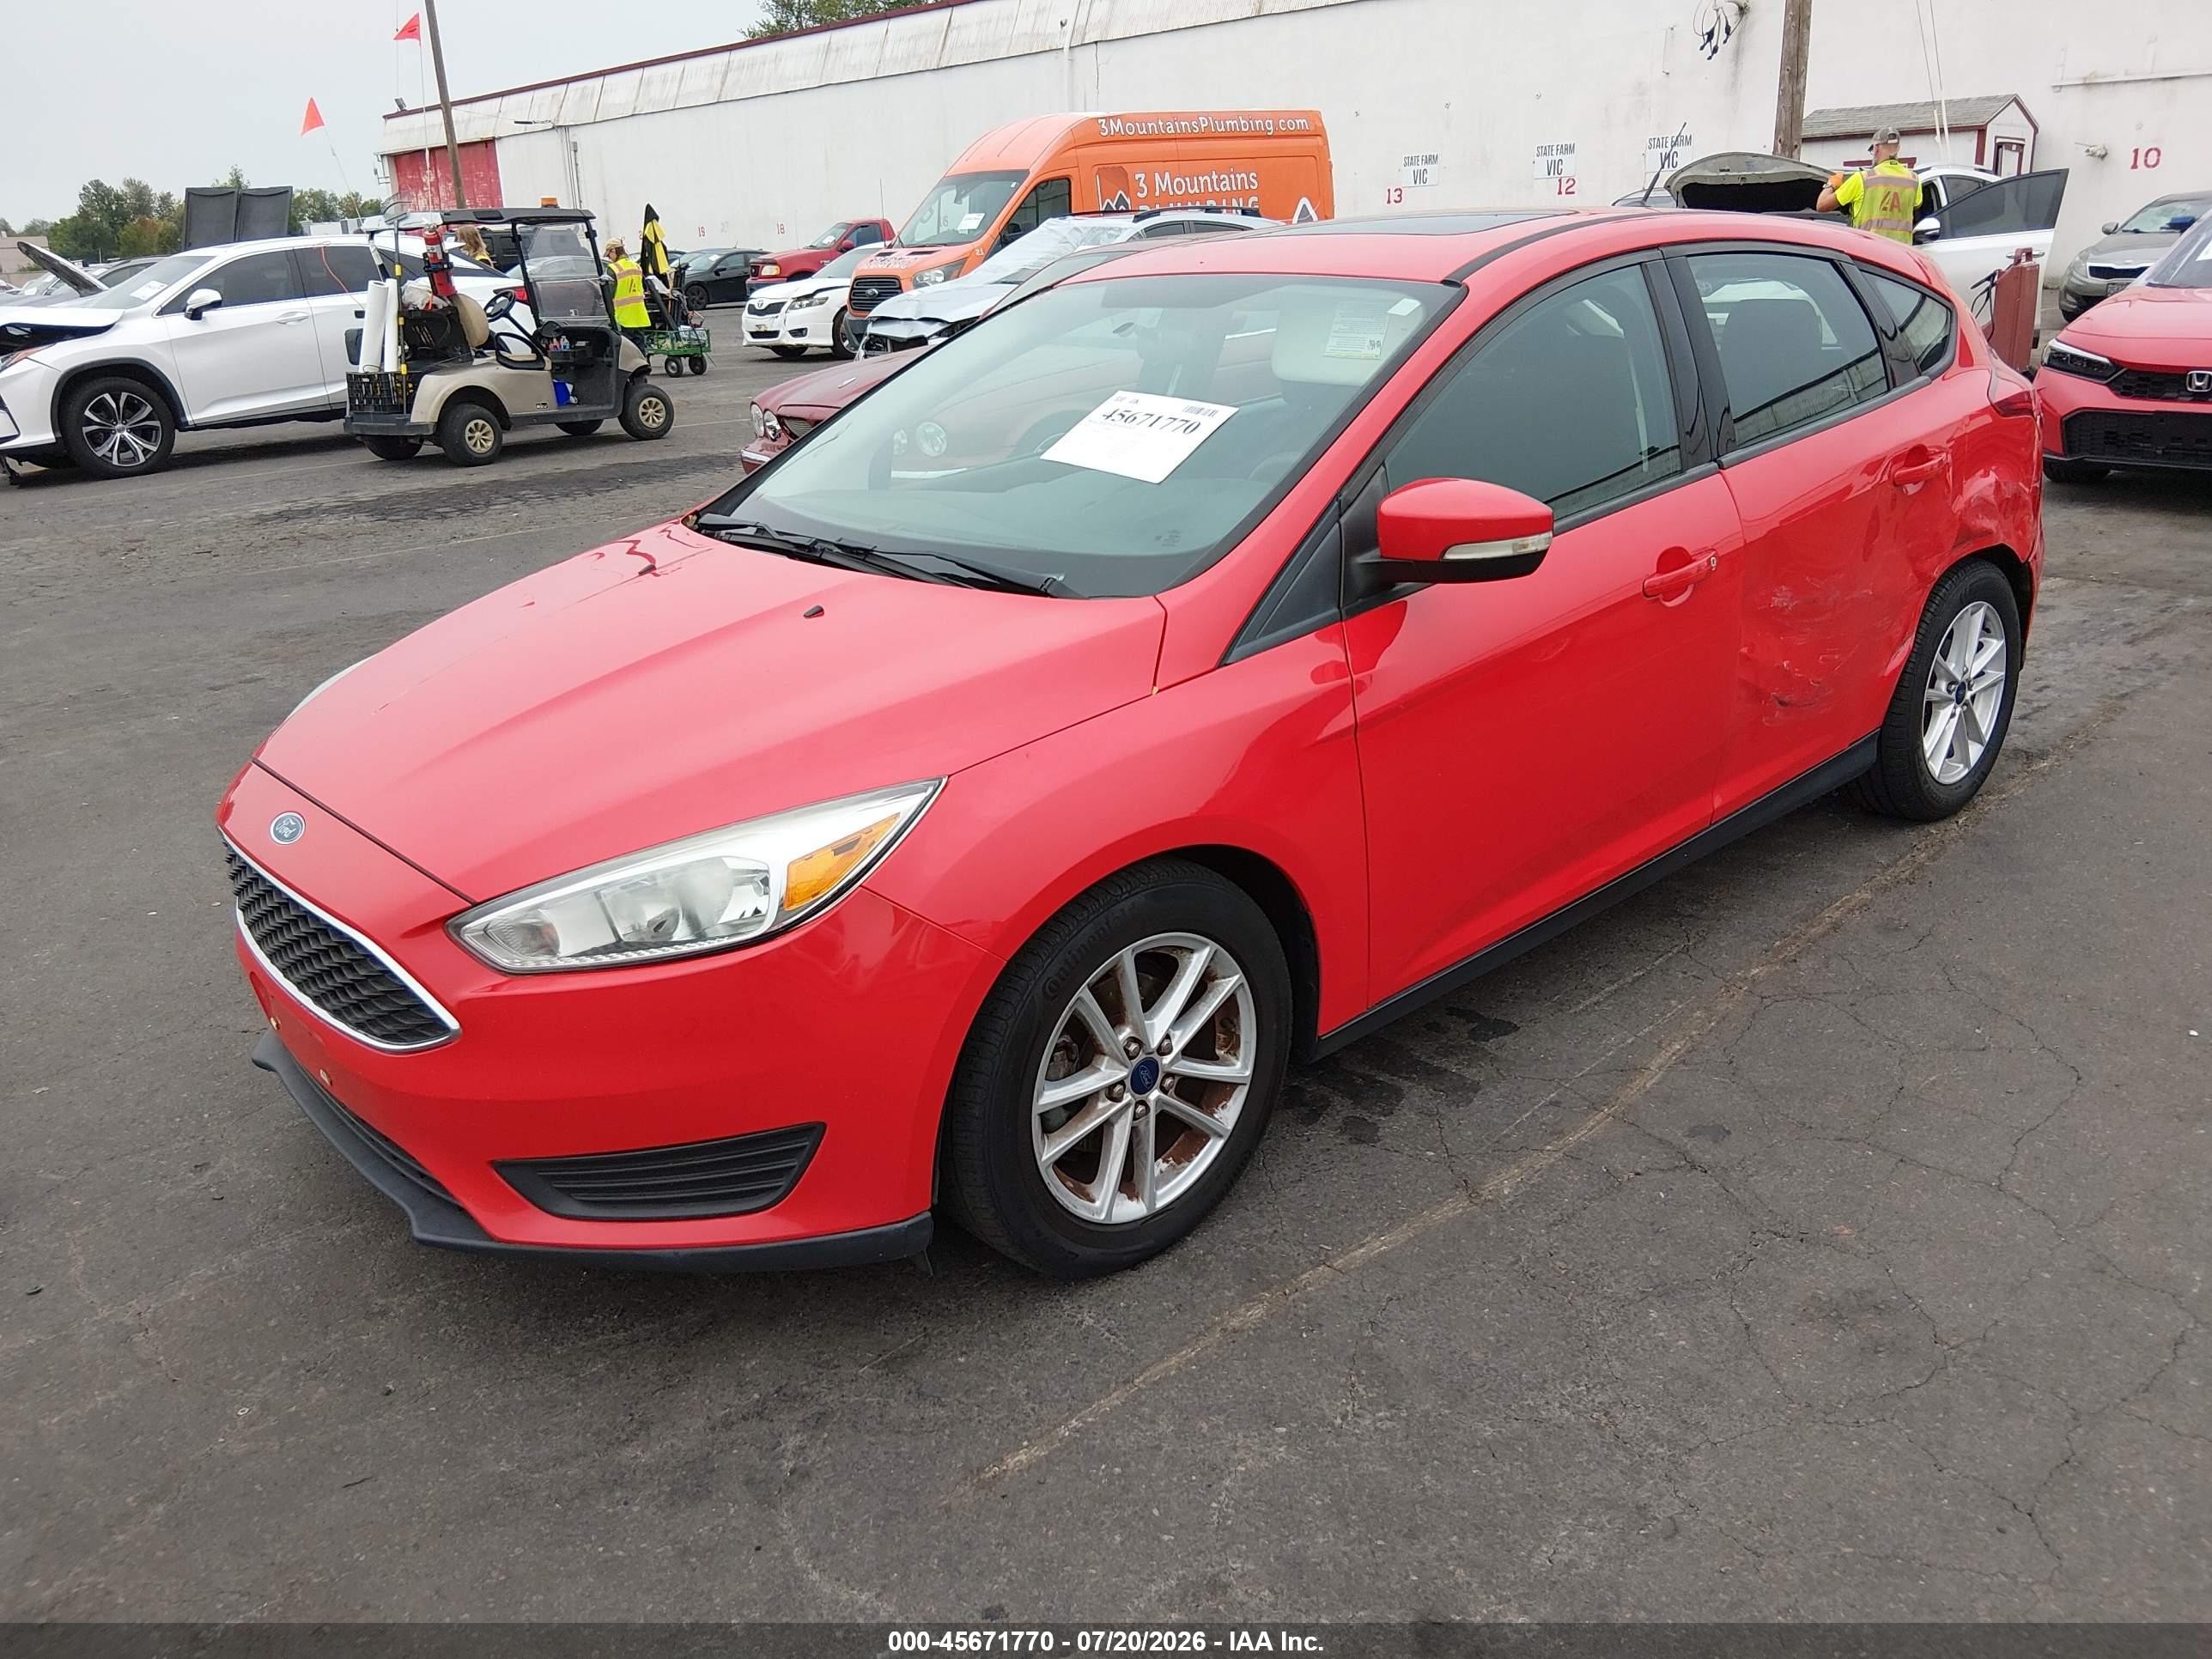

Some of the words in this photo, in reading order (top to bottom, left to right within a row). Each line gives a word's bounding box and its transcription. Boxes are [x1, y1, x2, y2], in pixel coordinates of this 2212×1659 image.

[1098, 116, 1310, 137] 3MountainsPlumbing.com
[1536, 145, 1555, 157] STATE
[1555, 143, 1576, 156] FARM
[1648, 137, 1669, 149] STATE
[1670, 134, 1692, 147] FARM
[1403, 155, 1420, 167] STATE
[1421, 154, 1438, 166] FARM
[1546, 158, 1564, 177] VIC
[1660, 150, 1679, 169] VIC
[2130, 147, 2161, 169] 10
[1134, 172, 1149, 198] 3
[1154, 167, 1259, 197] Mountains
[1413, 169, 1428, 185] VIC
[1386, 187, 1403, 204] 13
[1557, 178, 1577, 196] 12
[1102, 408, 1201, 434] 45671770
[275, 817, 297, 838] Ford
